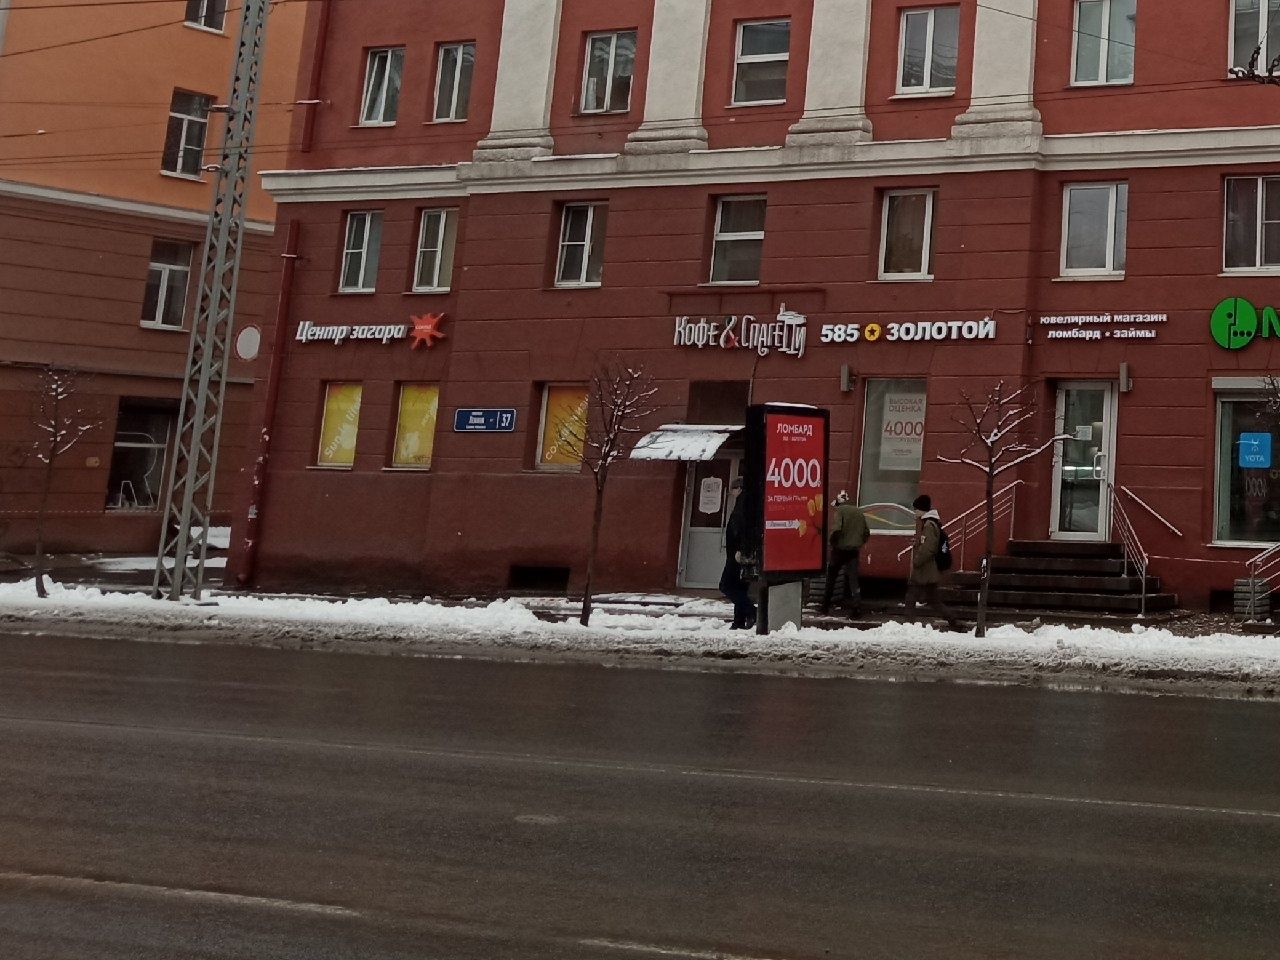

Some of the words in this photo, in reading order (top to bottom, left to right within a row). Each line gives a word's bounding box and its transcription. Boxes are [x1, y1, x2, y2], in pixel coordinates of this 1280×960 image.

[1040, 312, 1112, 326] ювелирный
[1113, 313, 1168, 323] магазин
[294, 320, 349, 345] Центр
[349, 324, 406, 345] загара
[819, 322, 861, 343] 585
[885, 316, 997, 341] ЗОЛОТОЙ
[1047, 328, 1102, 340] ломбард
[1112, 327, 1157, 338] займы
[501, 413, 512, 427] 37
[776, 423, 813, 437] ЛОМБАРД
[883, 421, 924, 436] 4000
